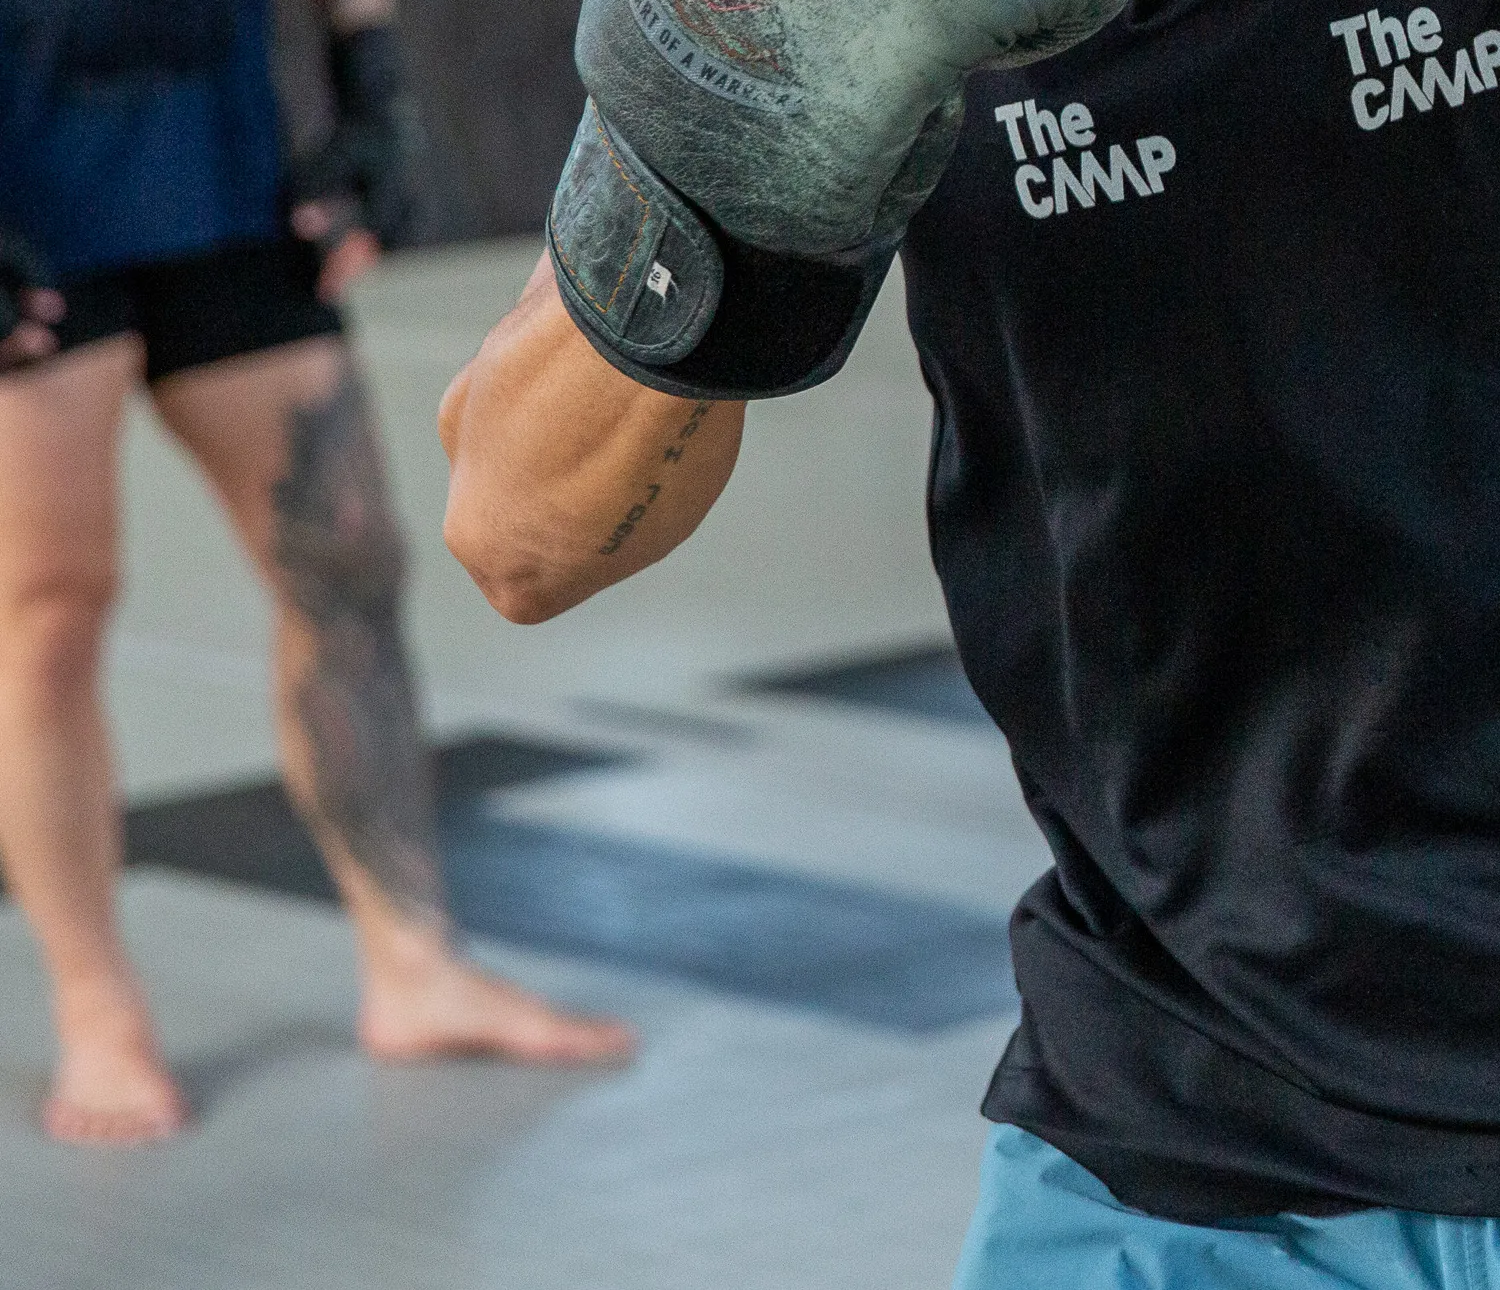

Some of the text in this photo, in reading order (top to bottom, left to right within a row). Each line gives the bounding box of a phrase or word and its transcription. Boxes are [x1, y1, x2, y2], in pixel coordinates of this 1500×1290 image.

[659, 28, 681, 52] OF
[680, 51, 695, 69] A
[700, 61, 790, 107] WARRR
[1329, 6, 1443, 76] The
[994, 98, 1097, 161] The
[1014, 135, 1177, 219] CAMP
